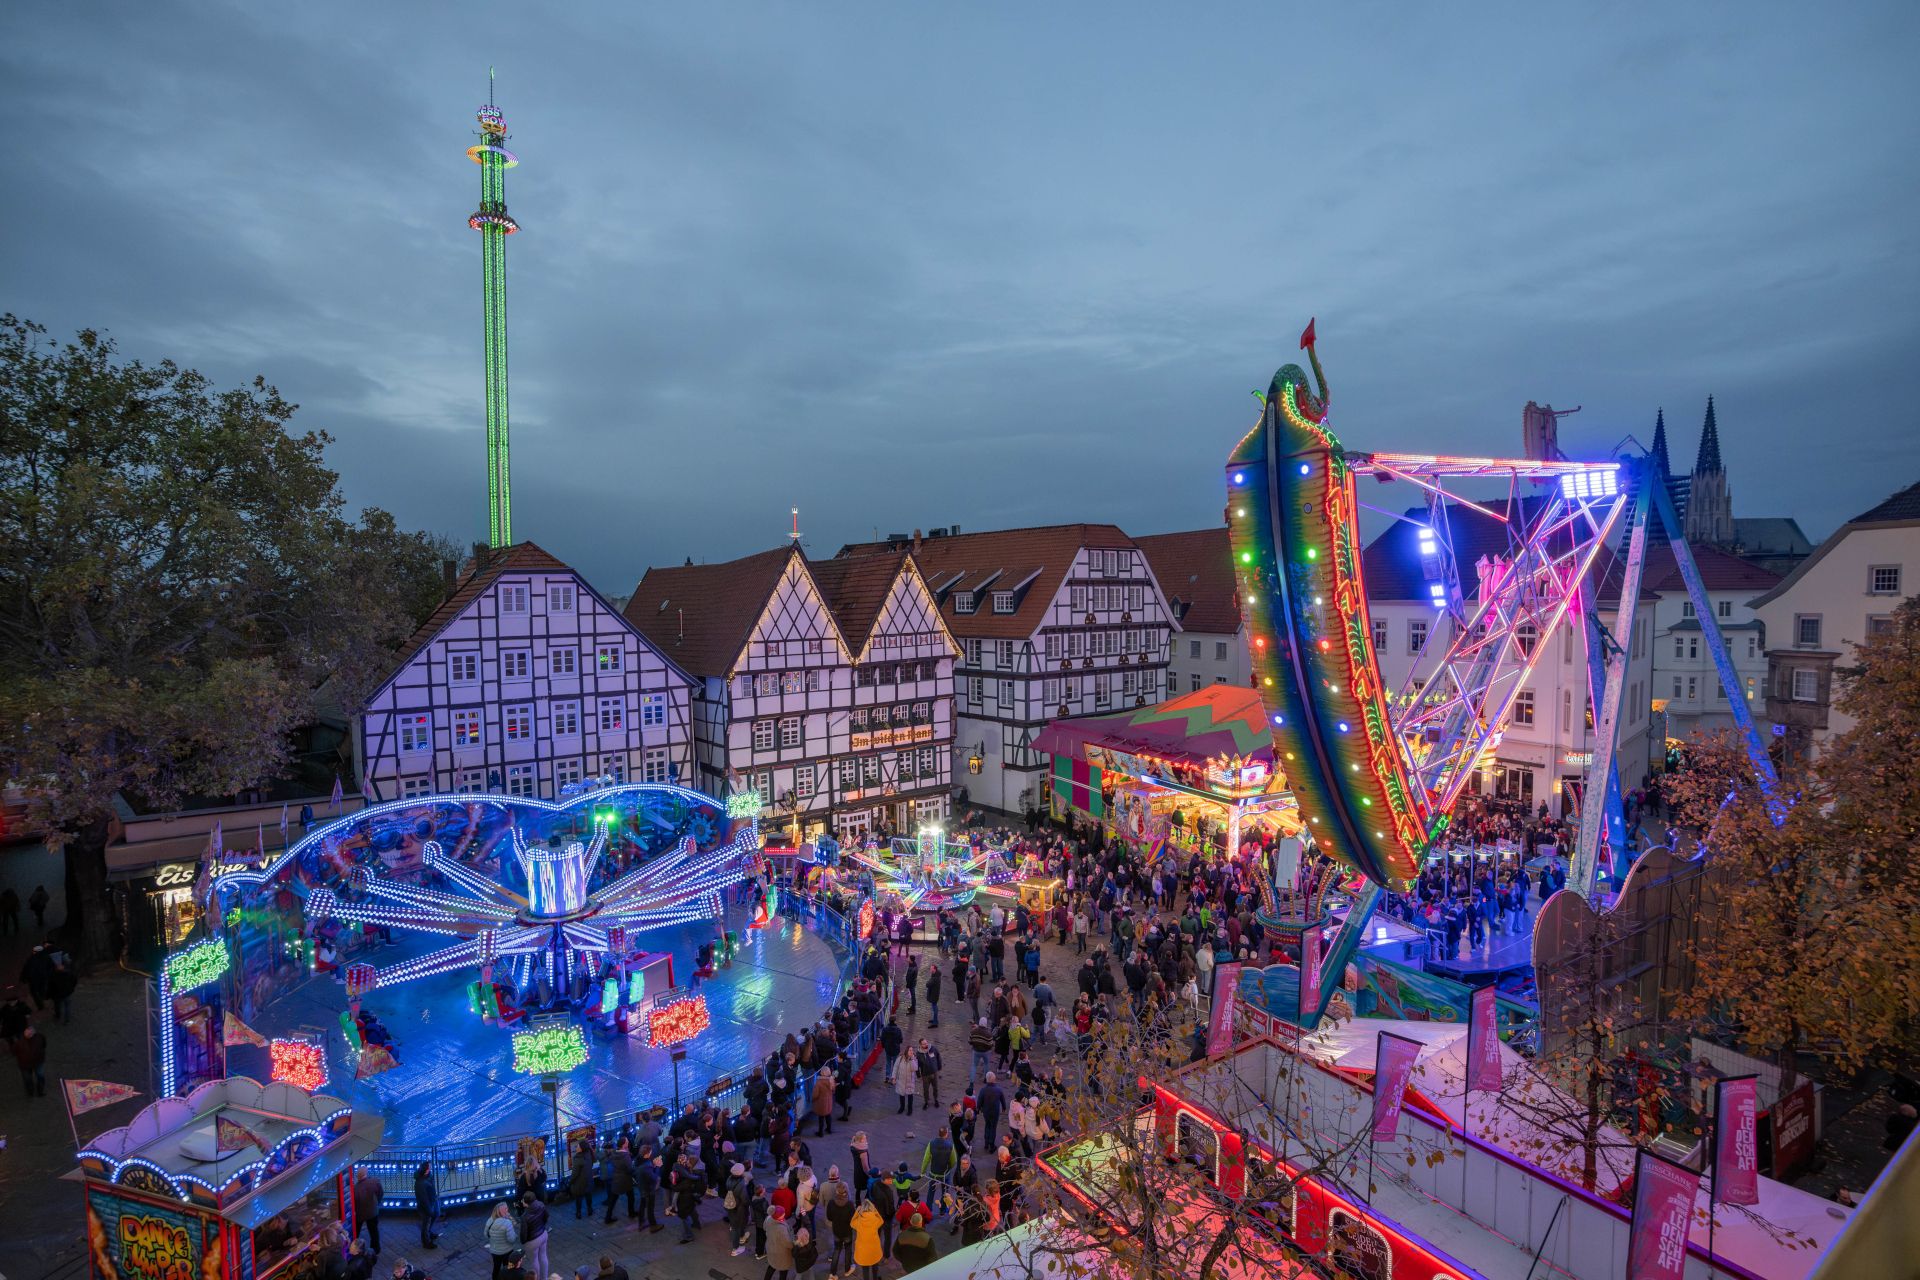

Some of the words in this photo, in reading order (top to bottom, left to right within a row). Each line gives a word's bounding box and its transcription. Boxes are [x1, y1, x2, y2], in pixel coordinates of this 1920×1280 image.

[156, 865, 194, 886] Eis
[171, 940, 227, 973] DANCE
[172, 957, 230, 993] JUMPER
[515, 1030, 580, 1053] DANCE
[516, 1047, 586, 1074] JUMPER
[1736, 1129, 1754, 1144] DEN
[1735, 1143, 1754, 1157] SCH
[1738, 1157, 1755, 1170] AFT
[1670, 1210, 1687, 1232] LEI
[122, 1216, 189, 1258] DANCE
[1661, 1221, 1685, 1246] DEN
[1659, 1236, 1683, 1259] SCH
[123, 1242, 194, 1280] JUMPER
[1657, 1252, 1681, 1273] AFT
